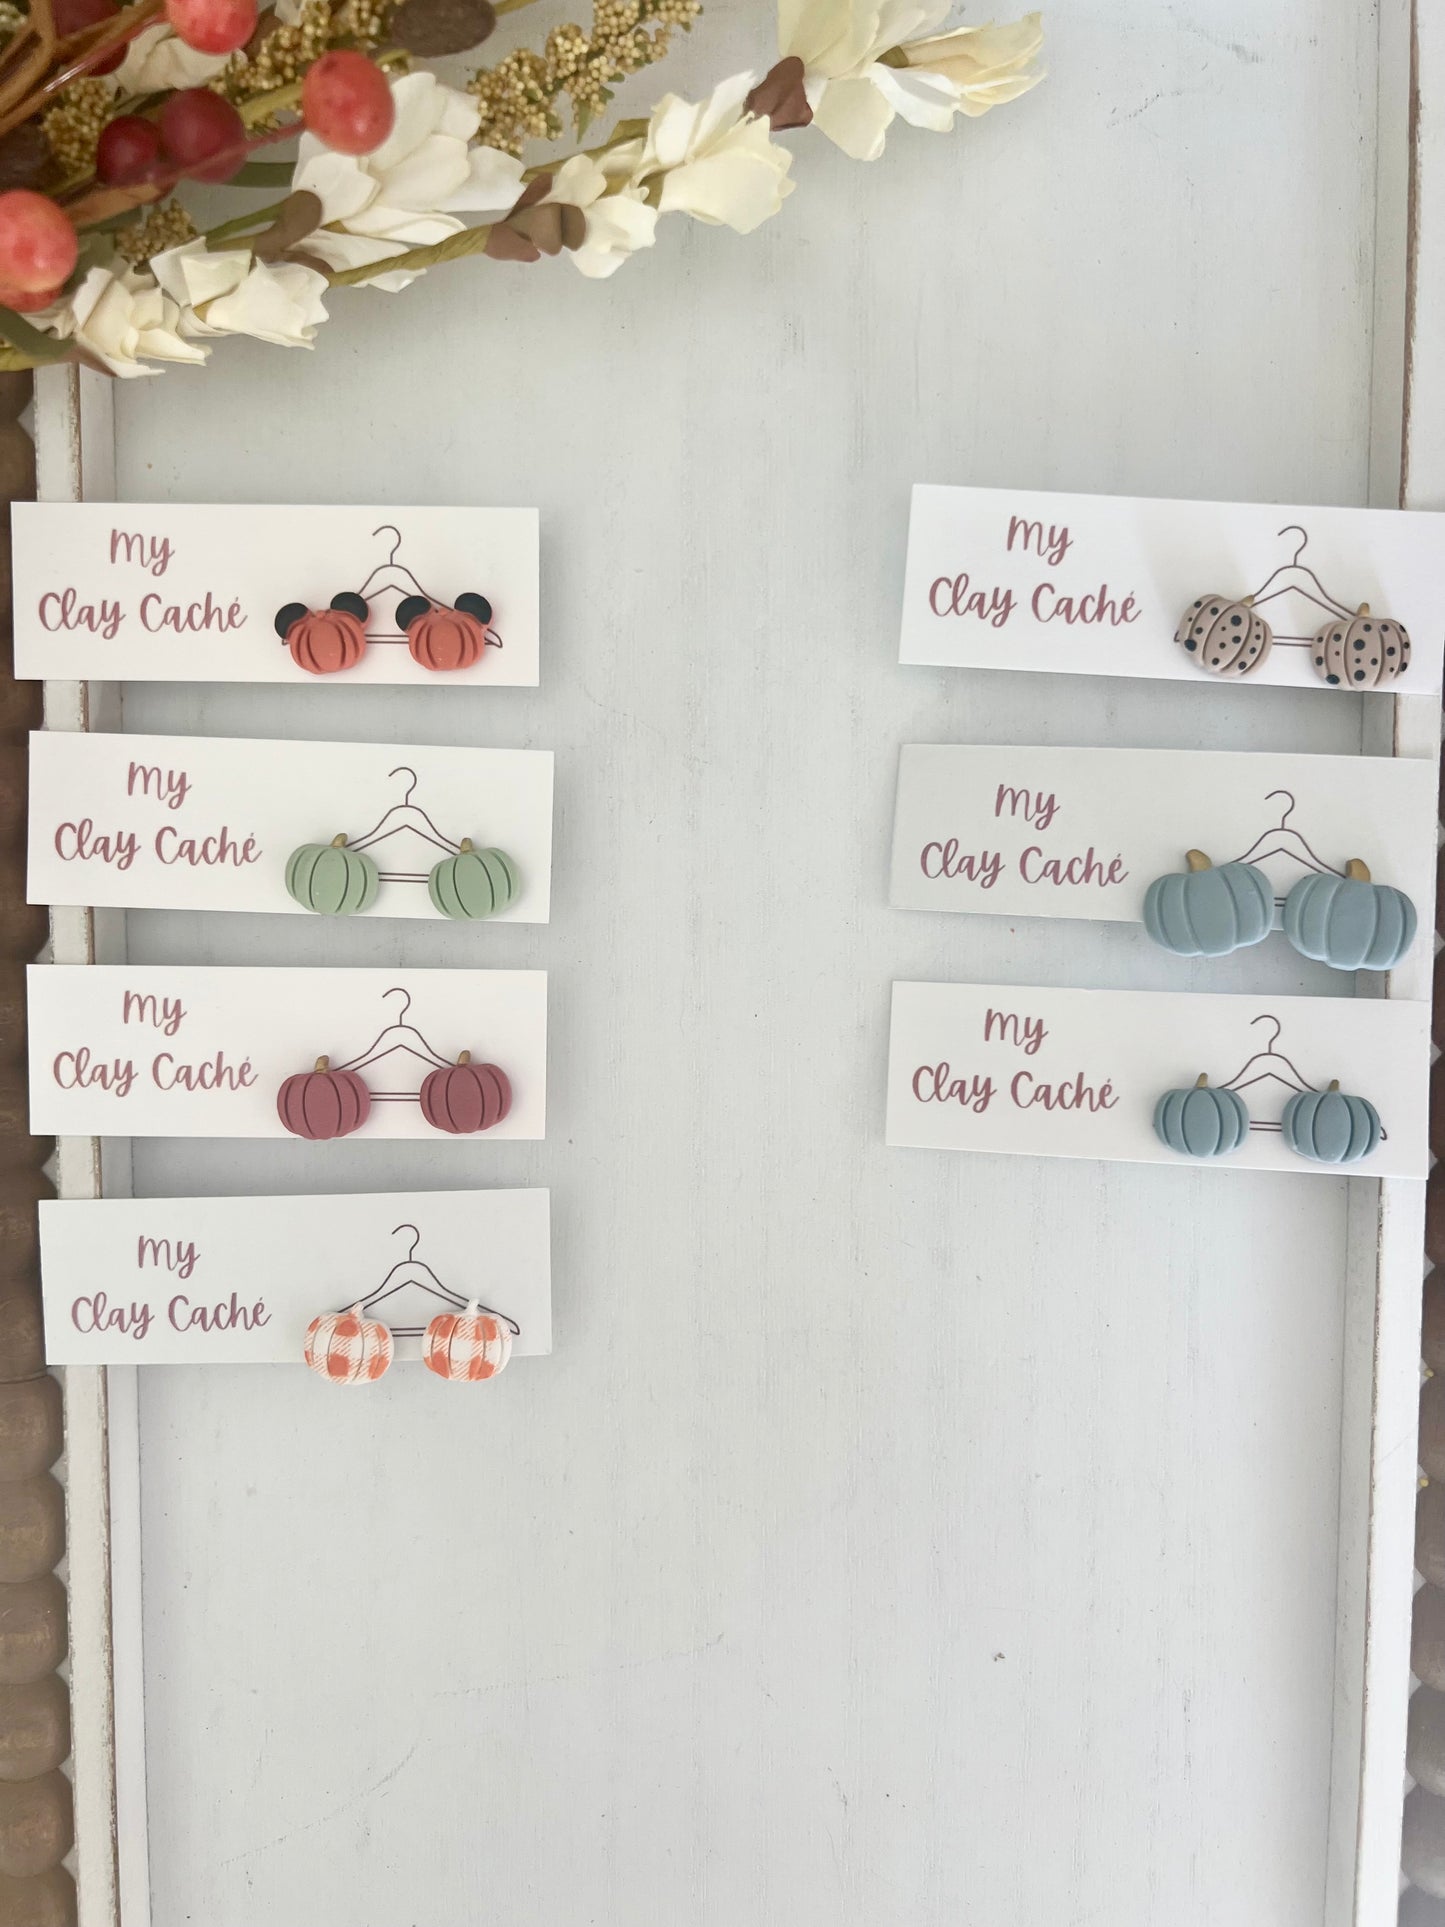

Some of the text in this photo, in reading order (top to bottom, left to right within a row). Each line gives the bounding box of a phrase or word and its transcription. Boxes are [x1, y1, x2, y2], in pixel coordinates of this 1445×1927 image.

[37, 586, 249, 641] Clay Caché
[928, 572, 1143, 629] Clay Caché
[53, 817, 264, 871] Clay Caché
[920, 837, 1130, 890] Clay Caché
[52, 1046, 260, 1098] Clay Caché
[911, 1061, 1121, 1114] Clay Caché
[70, 1291, 273, 1341] Clay Caché
